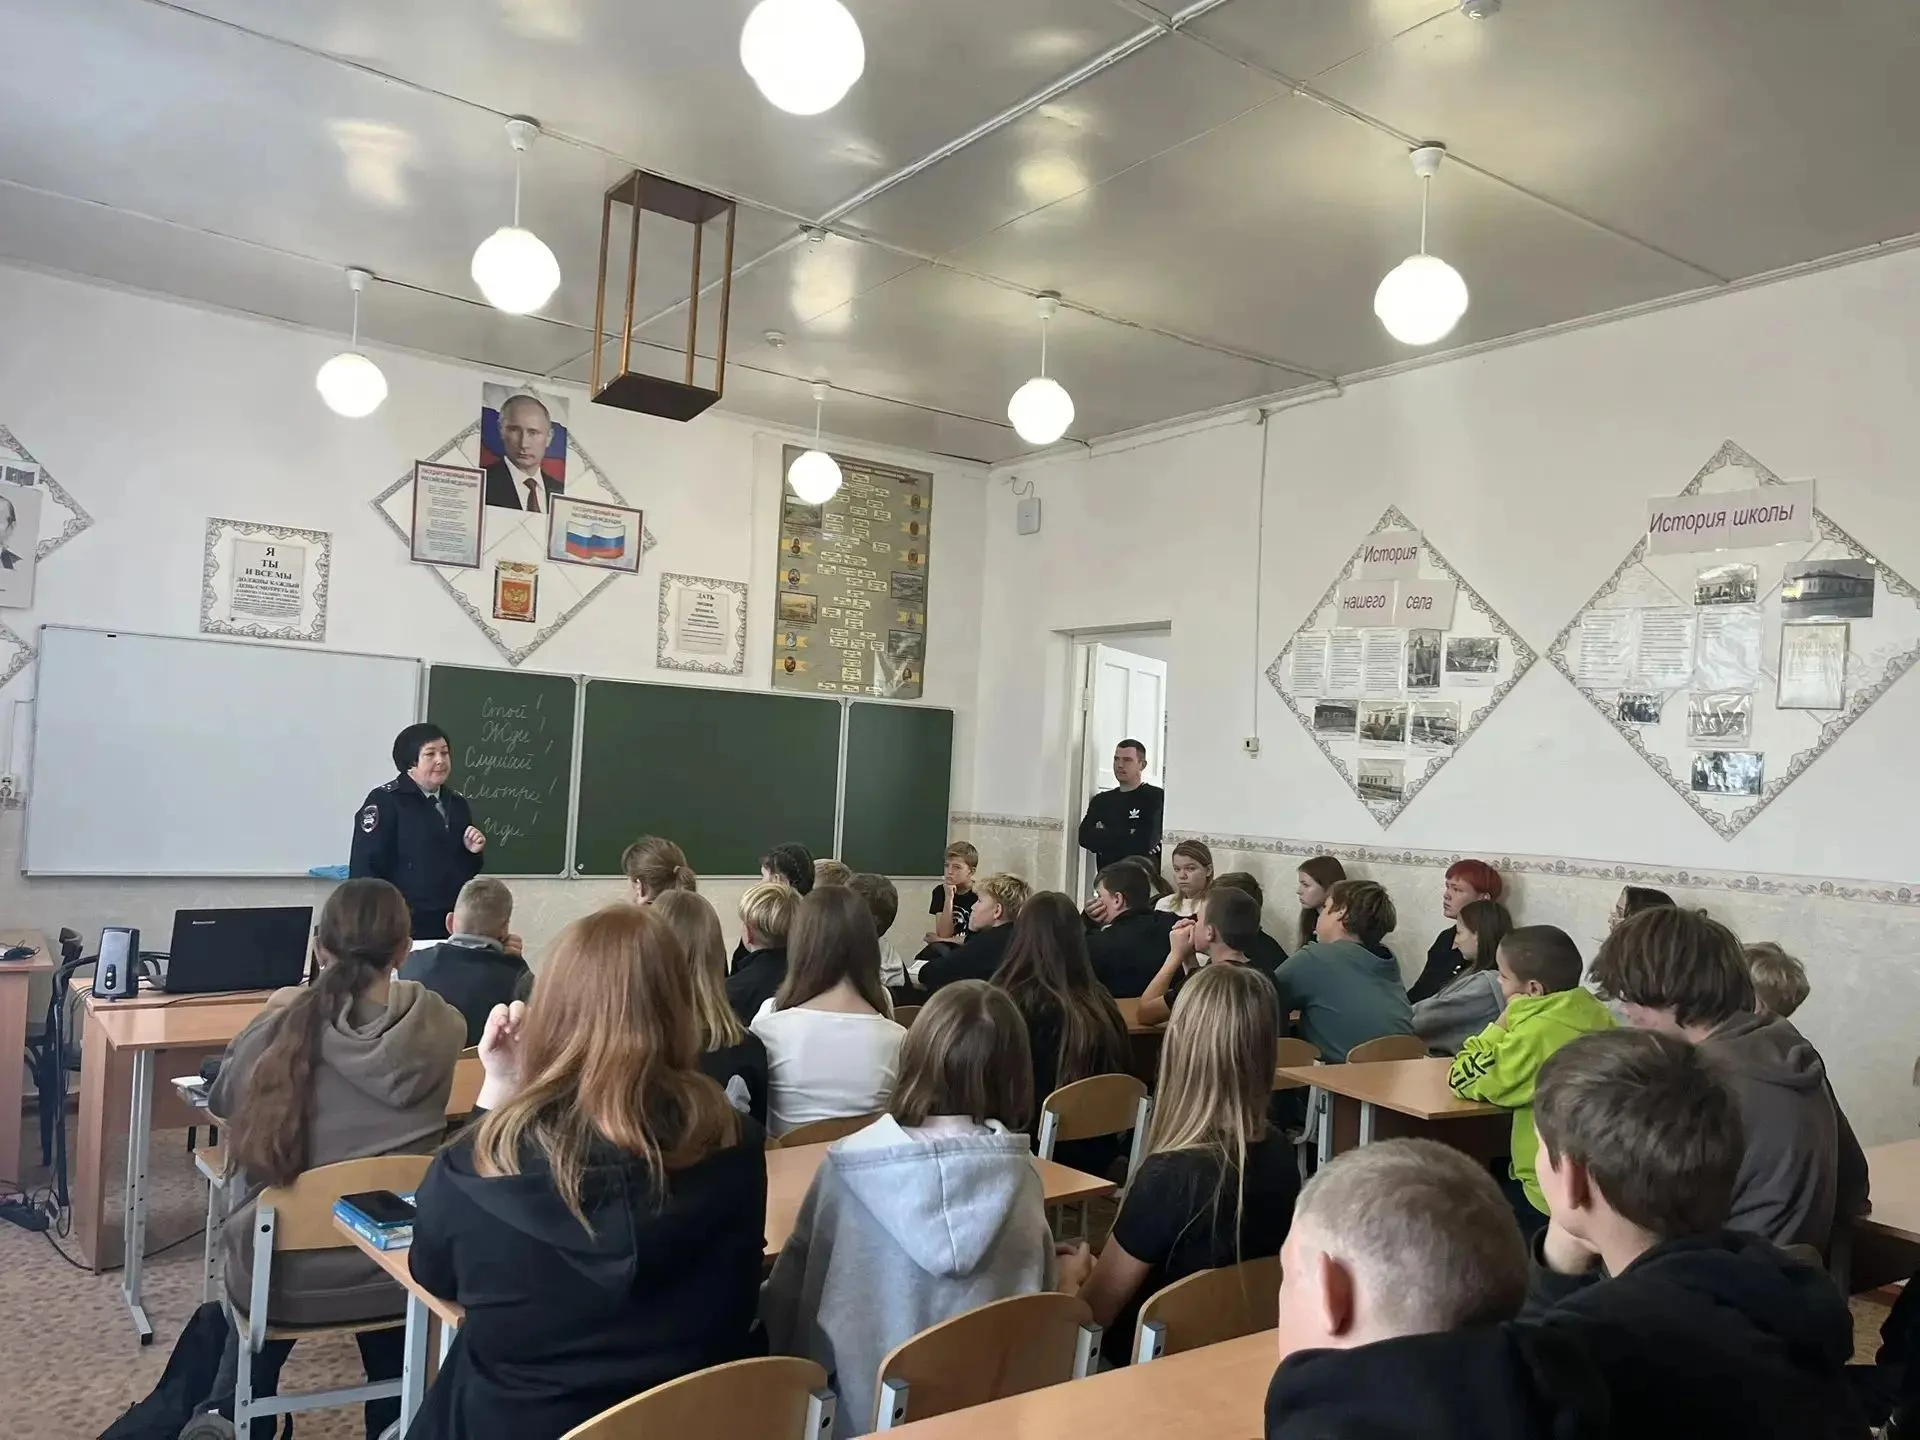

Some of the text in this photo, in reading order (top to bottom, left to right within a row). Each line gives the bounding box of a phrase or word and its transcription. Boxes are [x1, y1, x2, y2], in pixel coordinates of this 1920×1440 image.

[1649, 504, 1794, 534] История школы
[266, 547, 275, 556] Я
[1364, 546, 1418, 564] История
[260, 559, 279, 568] ТЫ
[255, 569, 273, 577] ВСЕ
[1343, 595, 1433, 610] нашего села
